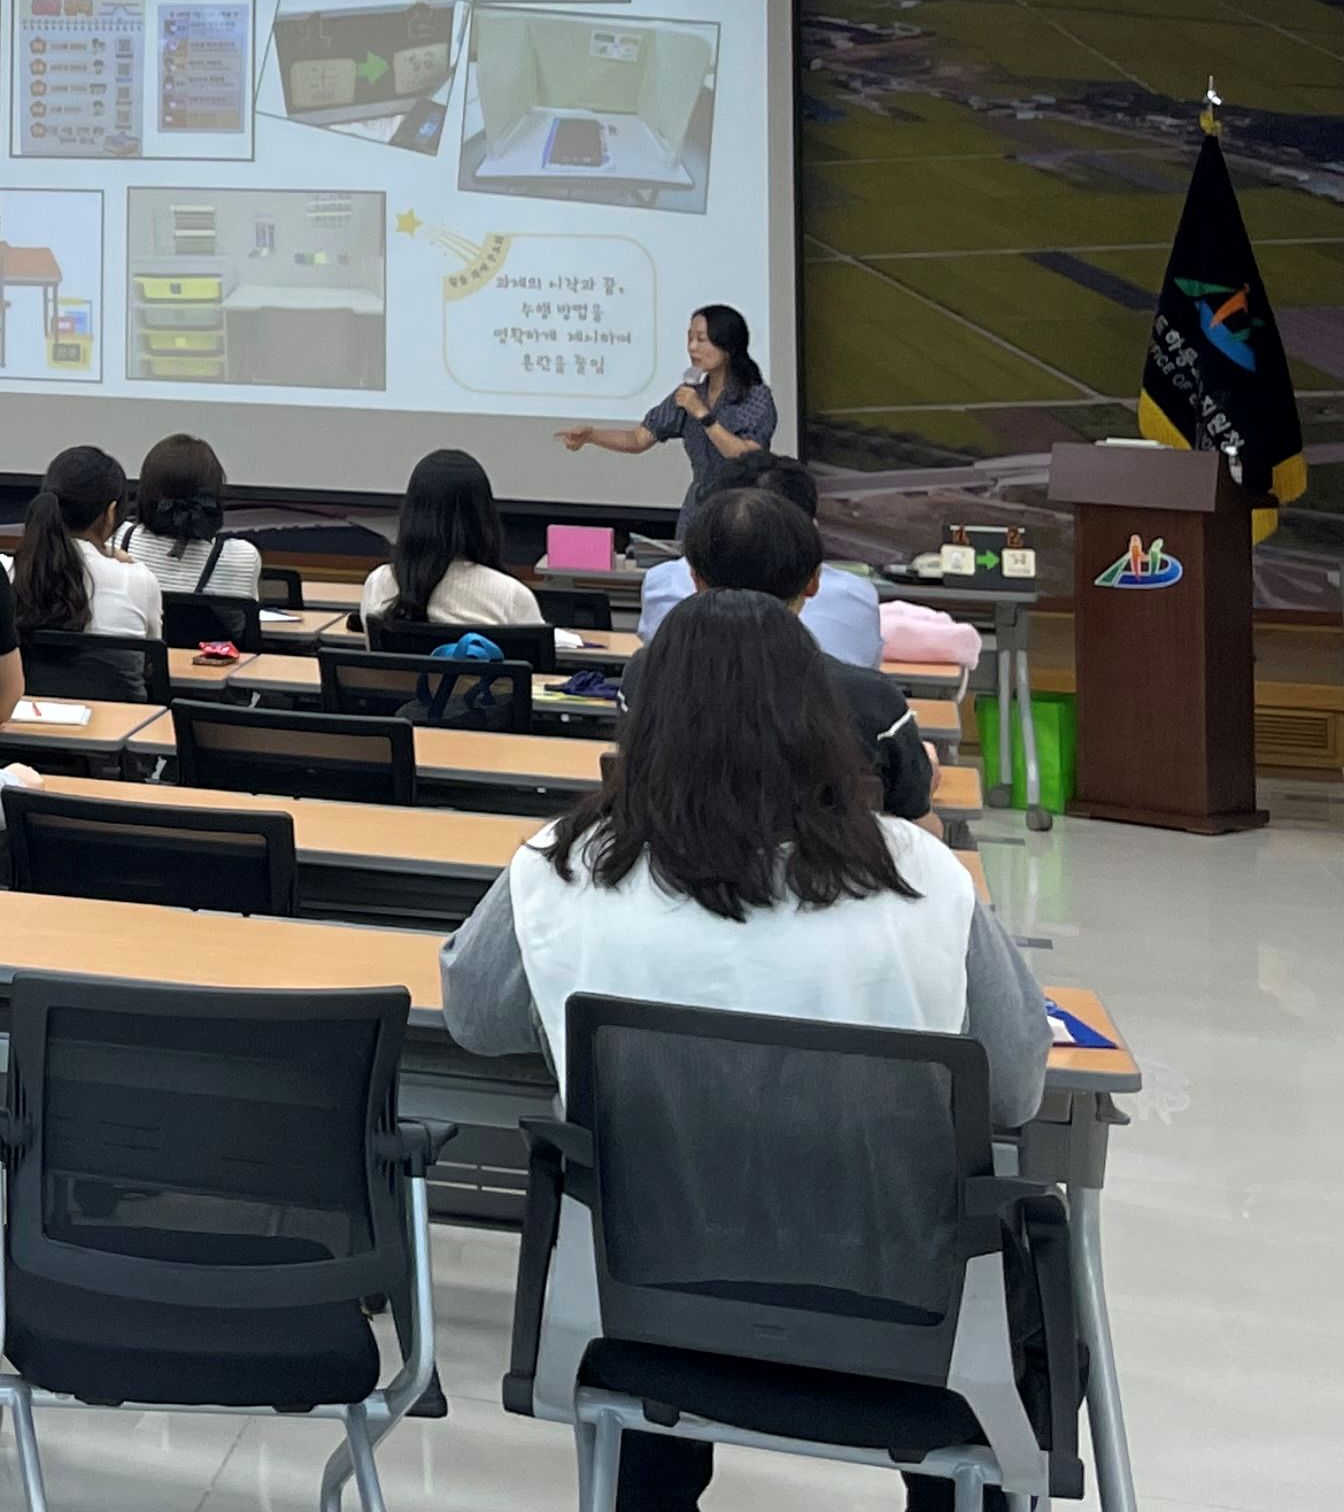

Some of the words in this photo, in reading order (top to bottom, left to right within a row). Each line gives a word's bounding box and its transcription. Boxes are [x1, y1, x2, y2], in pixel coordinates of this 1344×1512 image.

[495, 274, 542, 290] 과제의
[549, 275, 596, 294] 시작과
[521, 302, 552, 320] 수행
[556, 302, 604, 323] 방법을
[493, 327, 558, 345] 명확하게
[568, 329, 631, 345] 제시하며
[522, 353, 566, 374] 혼란을
[574, 354, 605, 375] 줄임
